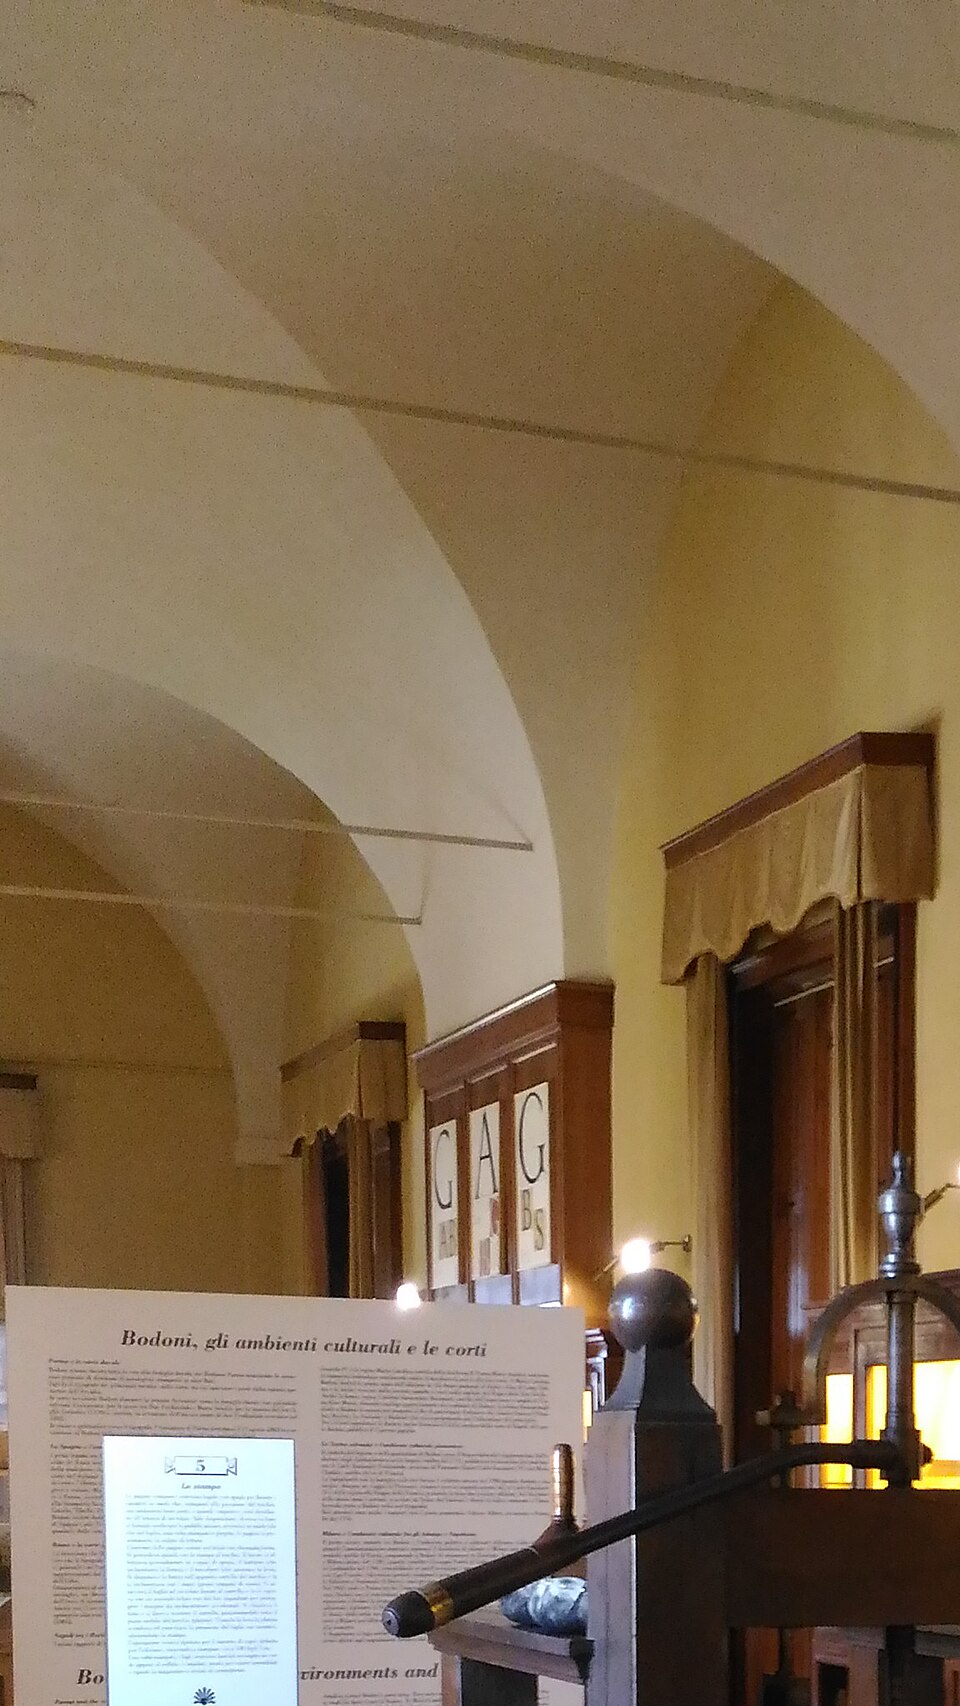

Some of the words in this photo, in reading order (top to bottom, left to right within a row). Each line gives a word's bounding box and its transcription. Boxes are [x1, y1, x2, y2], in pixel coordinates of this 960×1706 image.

[475, 1111, 499, 1200] A
[519, 1092, 545, 1184] G
[434, 1128, 453, 1209] G
[121, 1329, 198, 1348] Bodoni,
[205, 1332, 230, 1351] gli
[235, 1335, 317, 1352] ambienti
[324, 1337, 401, 1354] culturali
[407, 1344, 418, 1355] e
[424, 1340, 439, 1357] le
[445, 1342, 488, 1357] corti
[196, 1459, 206, 1472] 5
[300, 1666, 398, 1680] vironments
[404, 1662, 439, 1678] and
